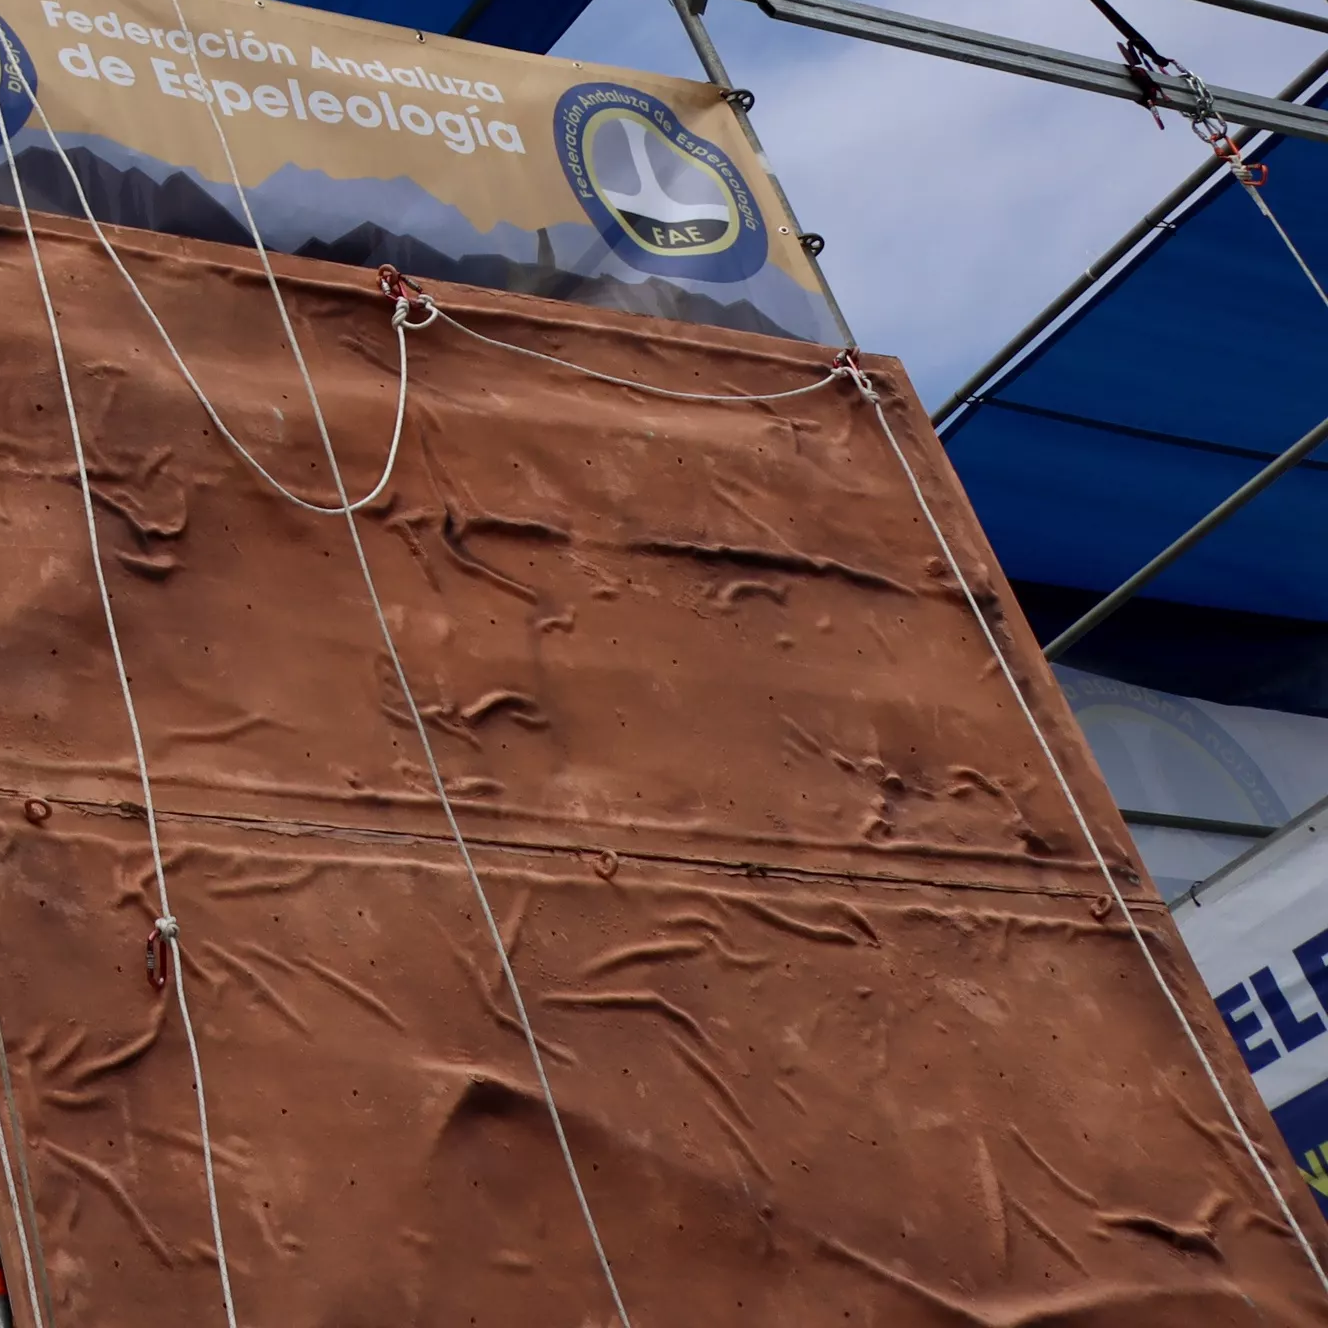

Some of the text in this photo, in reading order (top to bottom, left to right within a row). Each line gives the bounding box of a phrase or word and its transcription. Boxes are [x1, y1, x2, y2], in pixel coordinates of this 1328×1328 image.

[40, 0, 505, 104] Federación Andaluza
[57, 42, 527, 155] de Espeleología
[563, 88, 760, 232] Federación Andaluza de Espeleología
[651, 226, 706, 246] FAE
